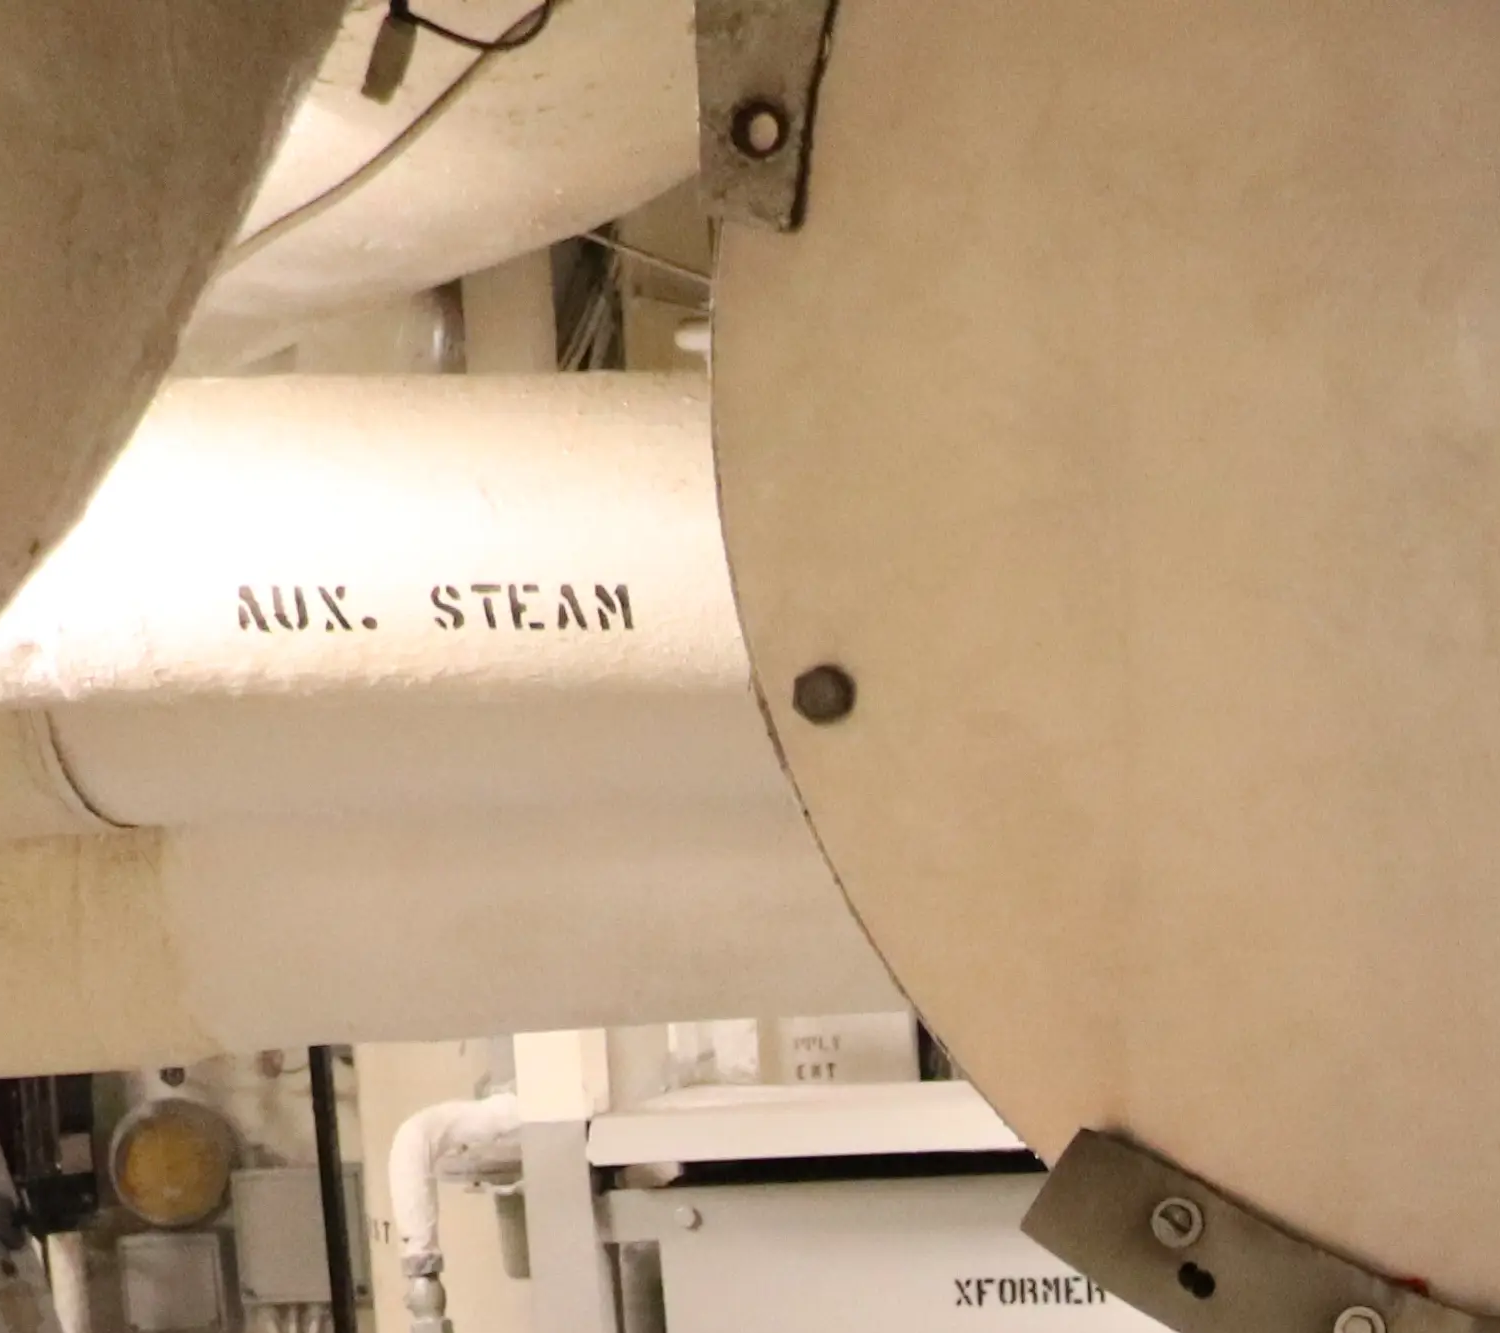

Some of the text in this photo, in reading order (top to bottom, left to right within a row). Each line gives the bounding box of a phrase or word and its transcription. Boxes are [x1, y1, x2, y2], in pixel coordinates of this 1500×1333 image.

[237, 583, 635, 632] AUX. STEAM
[953, 1276, 1107, 1307] XFORMER
